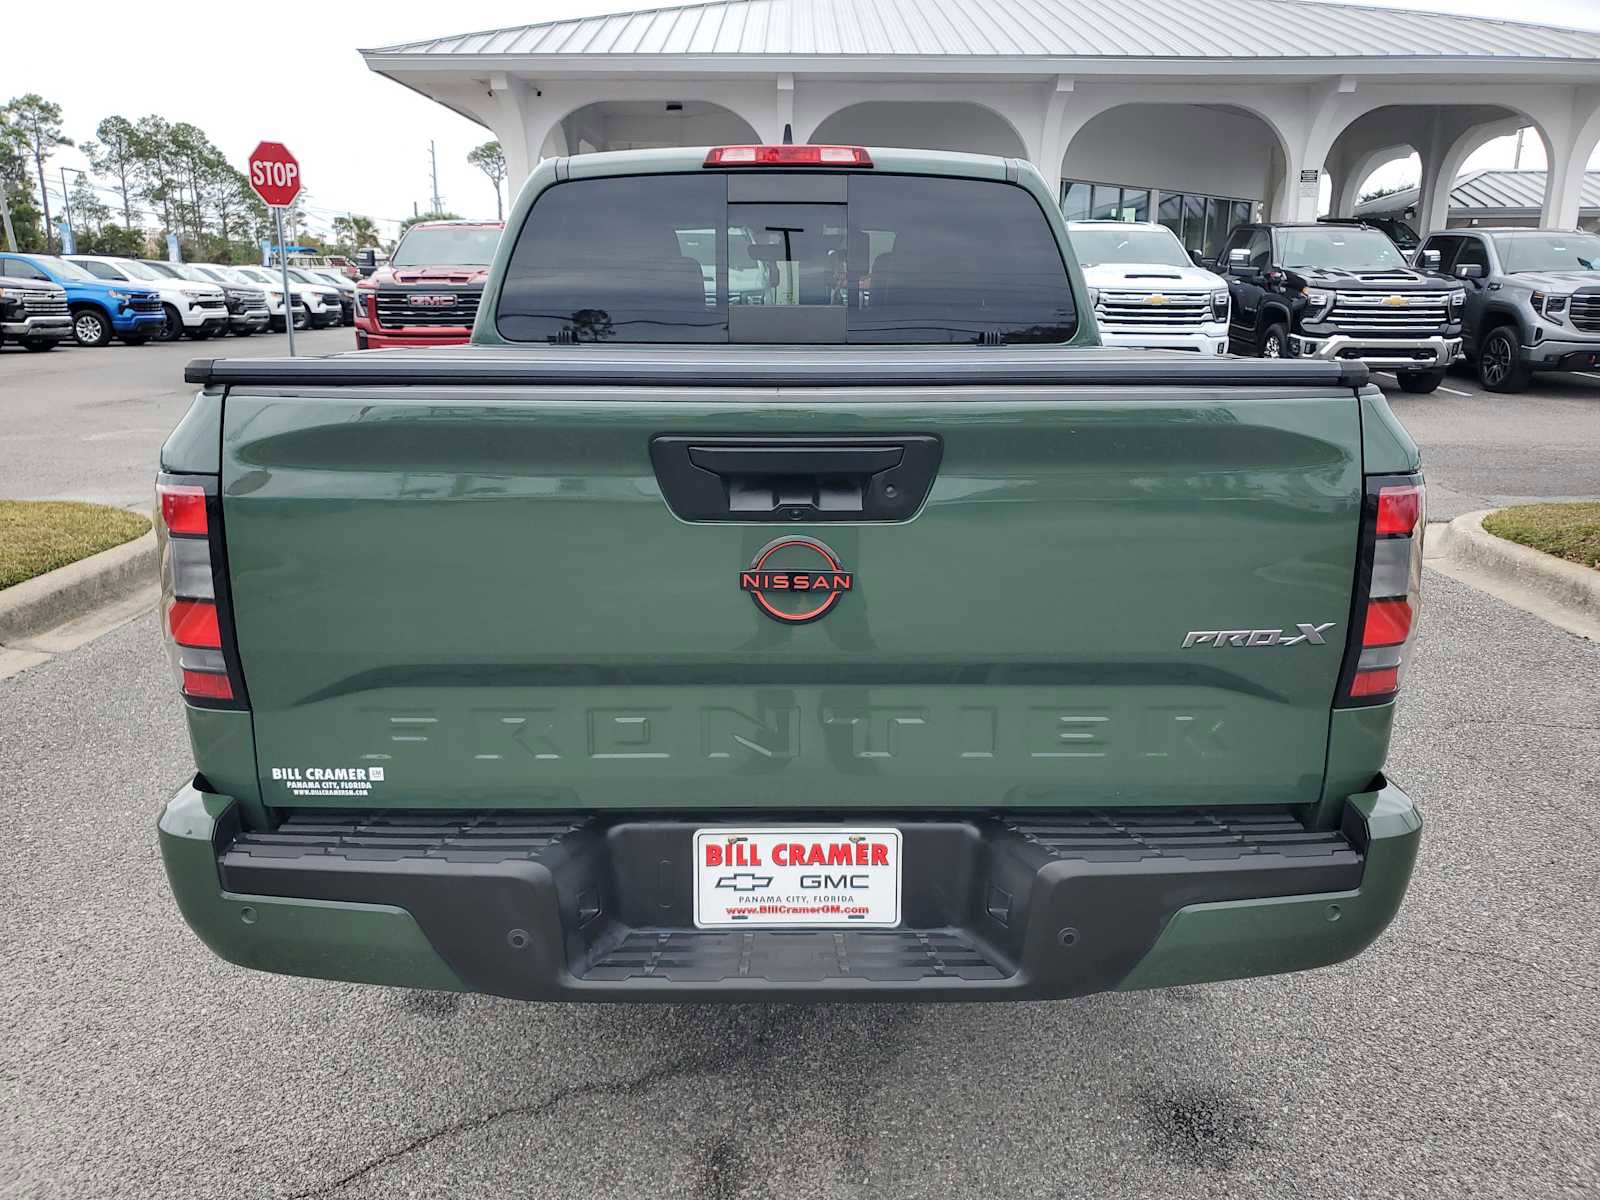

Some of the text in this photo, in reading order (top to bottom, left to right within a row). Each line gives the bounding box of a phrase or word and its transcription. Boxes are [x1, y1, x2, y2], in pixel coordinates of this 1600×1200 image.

[253, 160, 298, 187] STOP
[410, 296, 454, 306] GMC
[743, 574, 850, 589] NISSAN
[1181, 622, 1336, 648] PRO-X
[355, 706, 1226, 760] FRONTIER
[271, 767, 302, 780] BILL
[305, 767, 367, 780] CRAMER
[286, 781, 372, 790] PANAMA CITY, FLORIDA
[705, 842, 890, 867] BILL CRAMER
[799, 874, 870, 889] GMC
[738, 895, 855, 904] PANAMA CITY, FLORIDA
[725, 905, 870, 915] www.BillCramerGM.com
